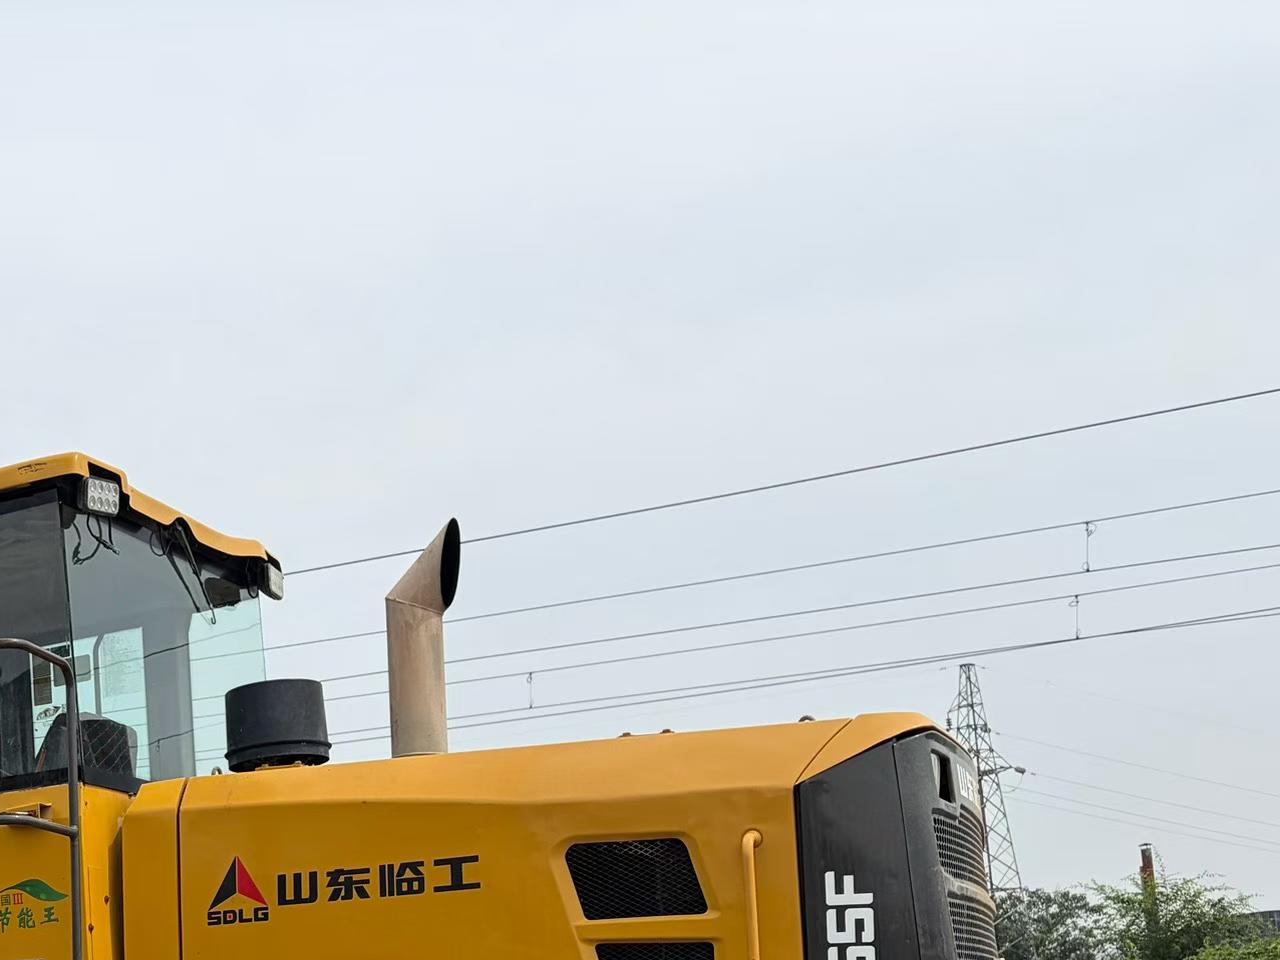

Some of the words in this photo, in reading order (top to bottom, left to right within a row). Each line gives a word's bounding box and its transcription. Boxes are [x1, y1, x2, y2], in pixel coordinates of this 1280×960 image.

[277, 855, 481, 906] 山东临工
[207, 906, 269, 926] SDLG
